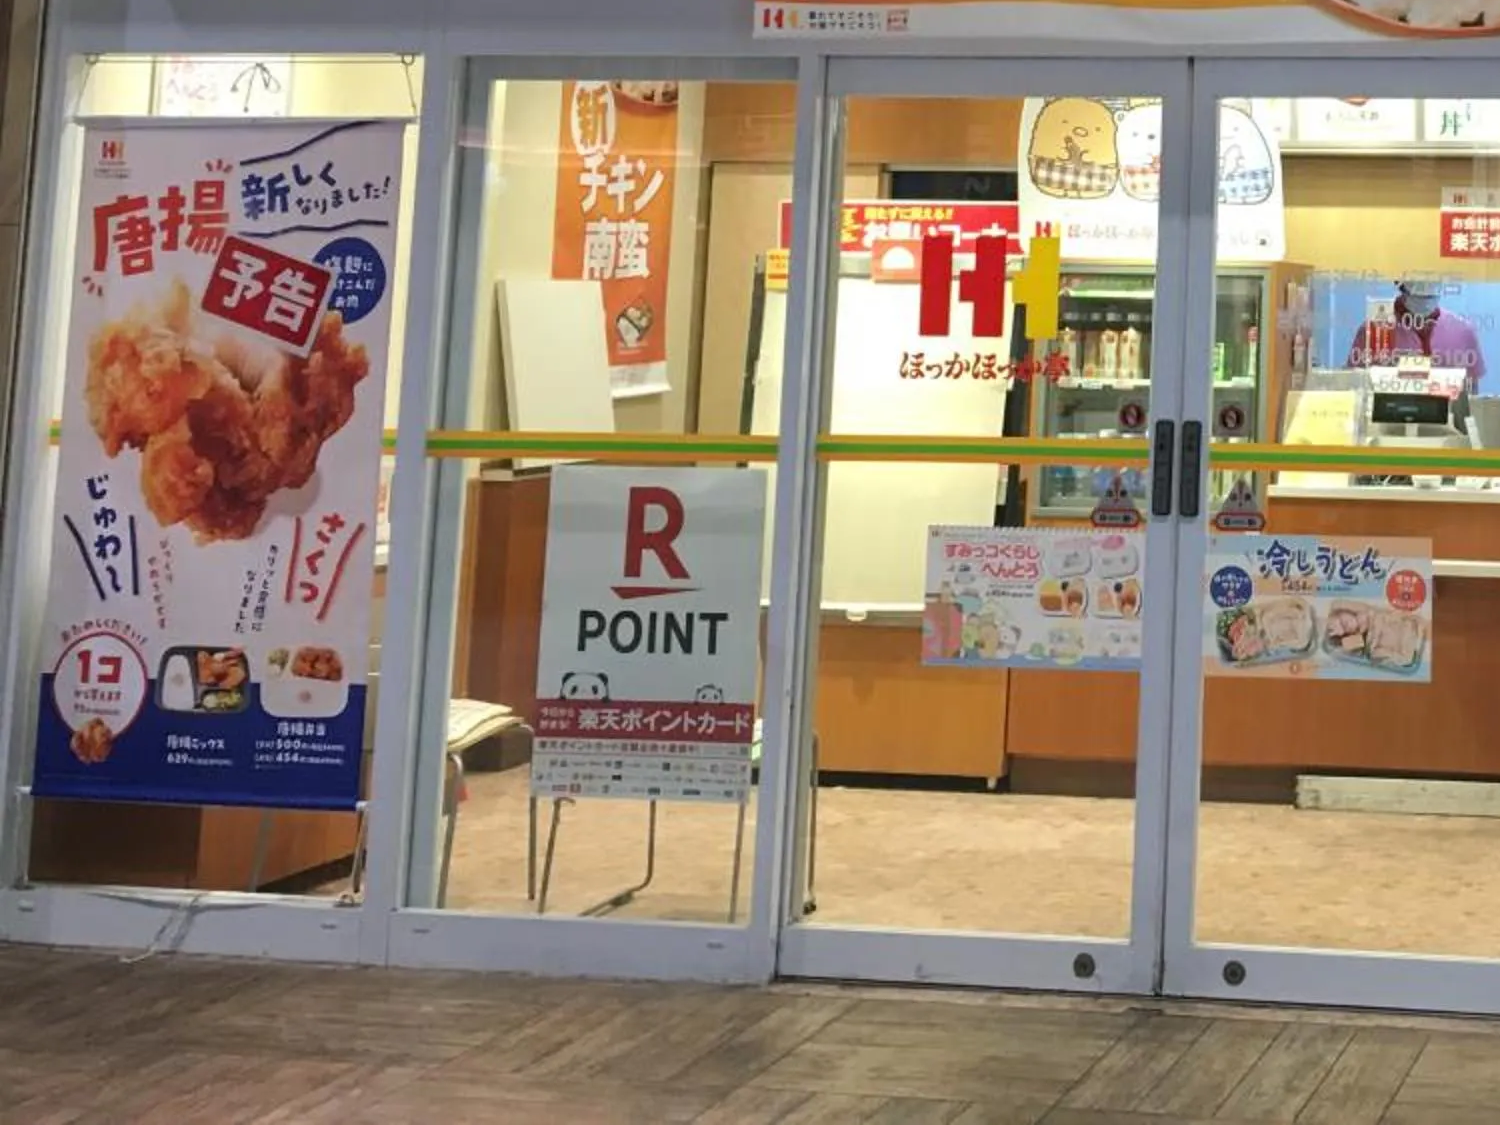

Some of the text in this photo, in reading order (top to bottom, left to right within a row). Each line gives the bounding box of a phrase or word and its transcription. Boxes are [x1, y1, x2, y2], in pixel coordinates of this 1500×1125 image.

[241, 161, 338, 220] 新しく
[296, 175, 391, 216] なりました!
[579, 151, 664, 214] チキン
[93, 178, 230, 277] 唐揚
[219, 250, 318, 333] 予告
[899, 350, 1072, 381] ほっかほっか亭
[1256, 538, 1384, 585] 冷しうどん
[577, 609, 729, 655] POINT
[77, 649, 123, 684] 1コ
[578, 708, 750, 735] 楽天ポイントカード
